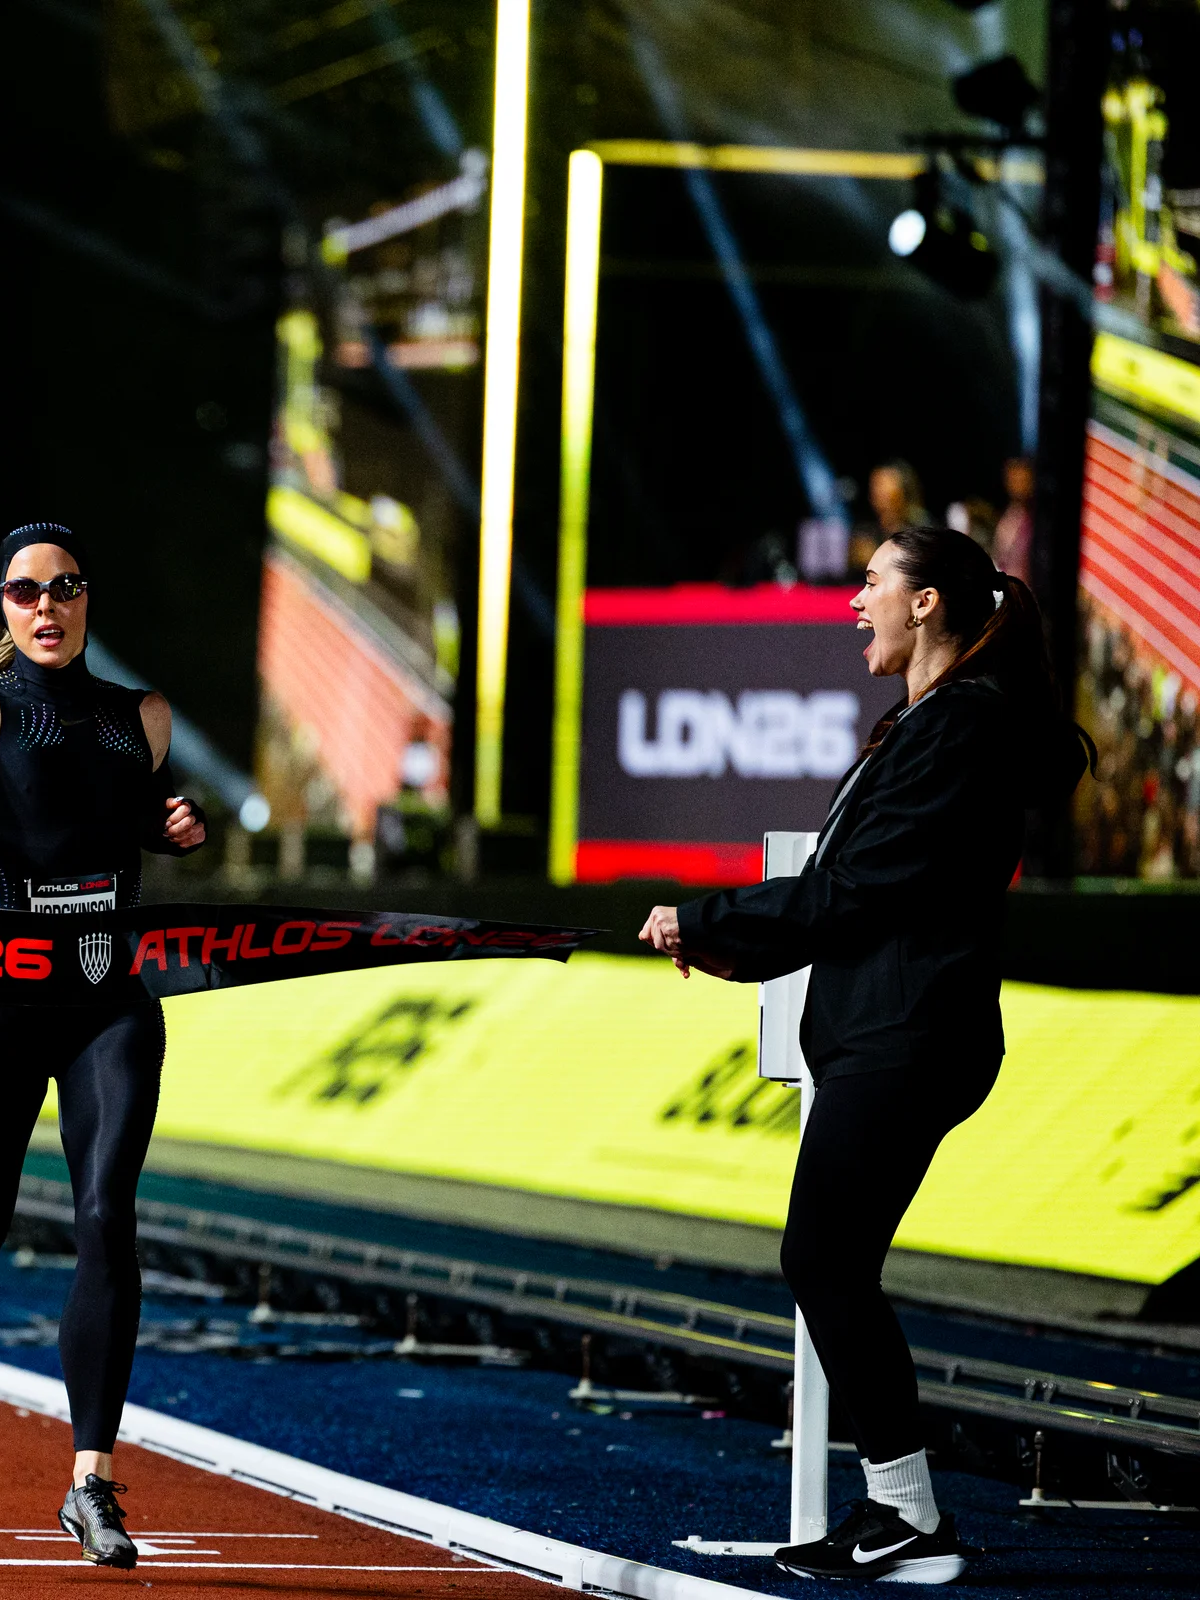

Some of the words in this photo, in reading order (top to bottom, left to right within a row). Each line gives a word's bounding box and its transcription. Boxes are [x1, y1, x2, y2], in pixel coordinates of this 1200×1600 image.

[618, 688, 858, 778] LDN26
[37, 884, 79, 892] ATHLOS
[129, 921, 361, 975] ATHLOS
